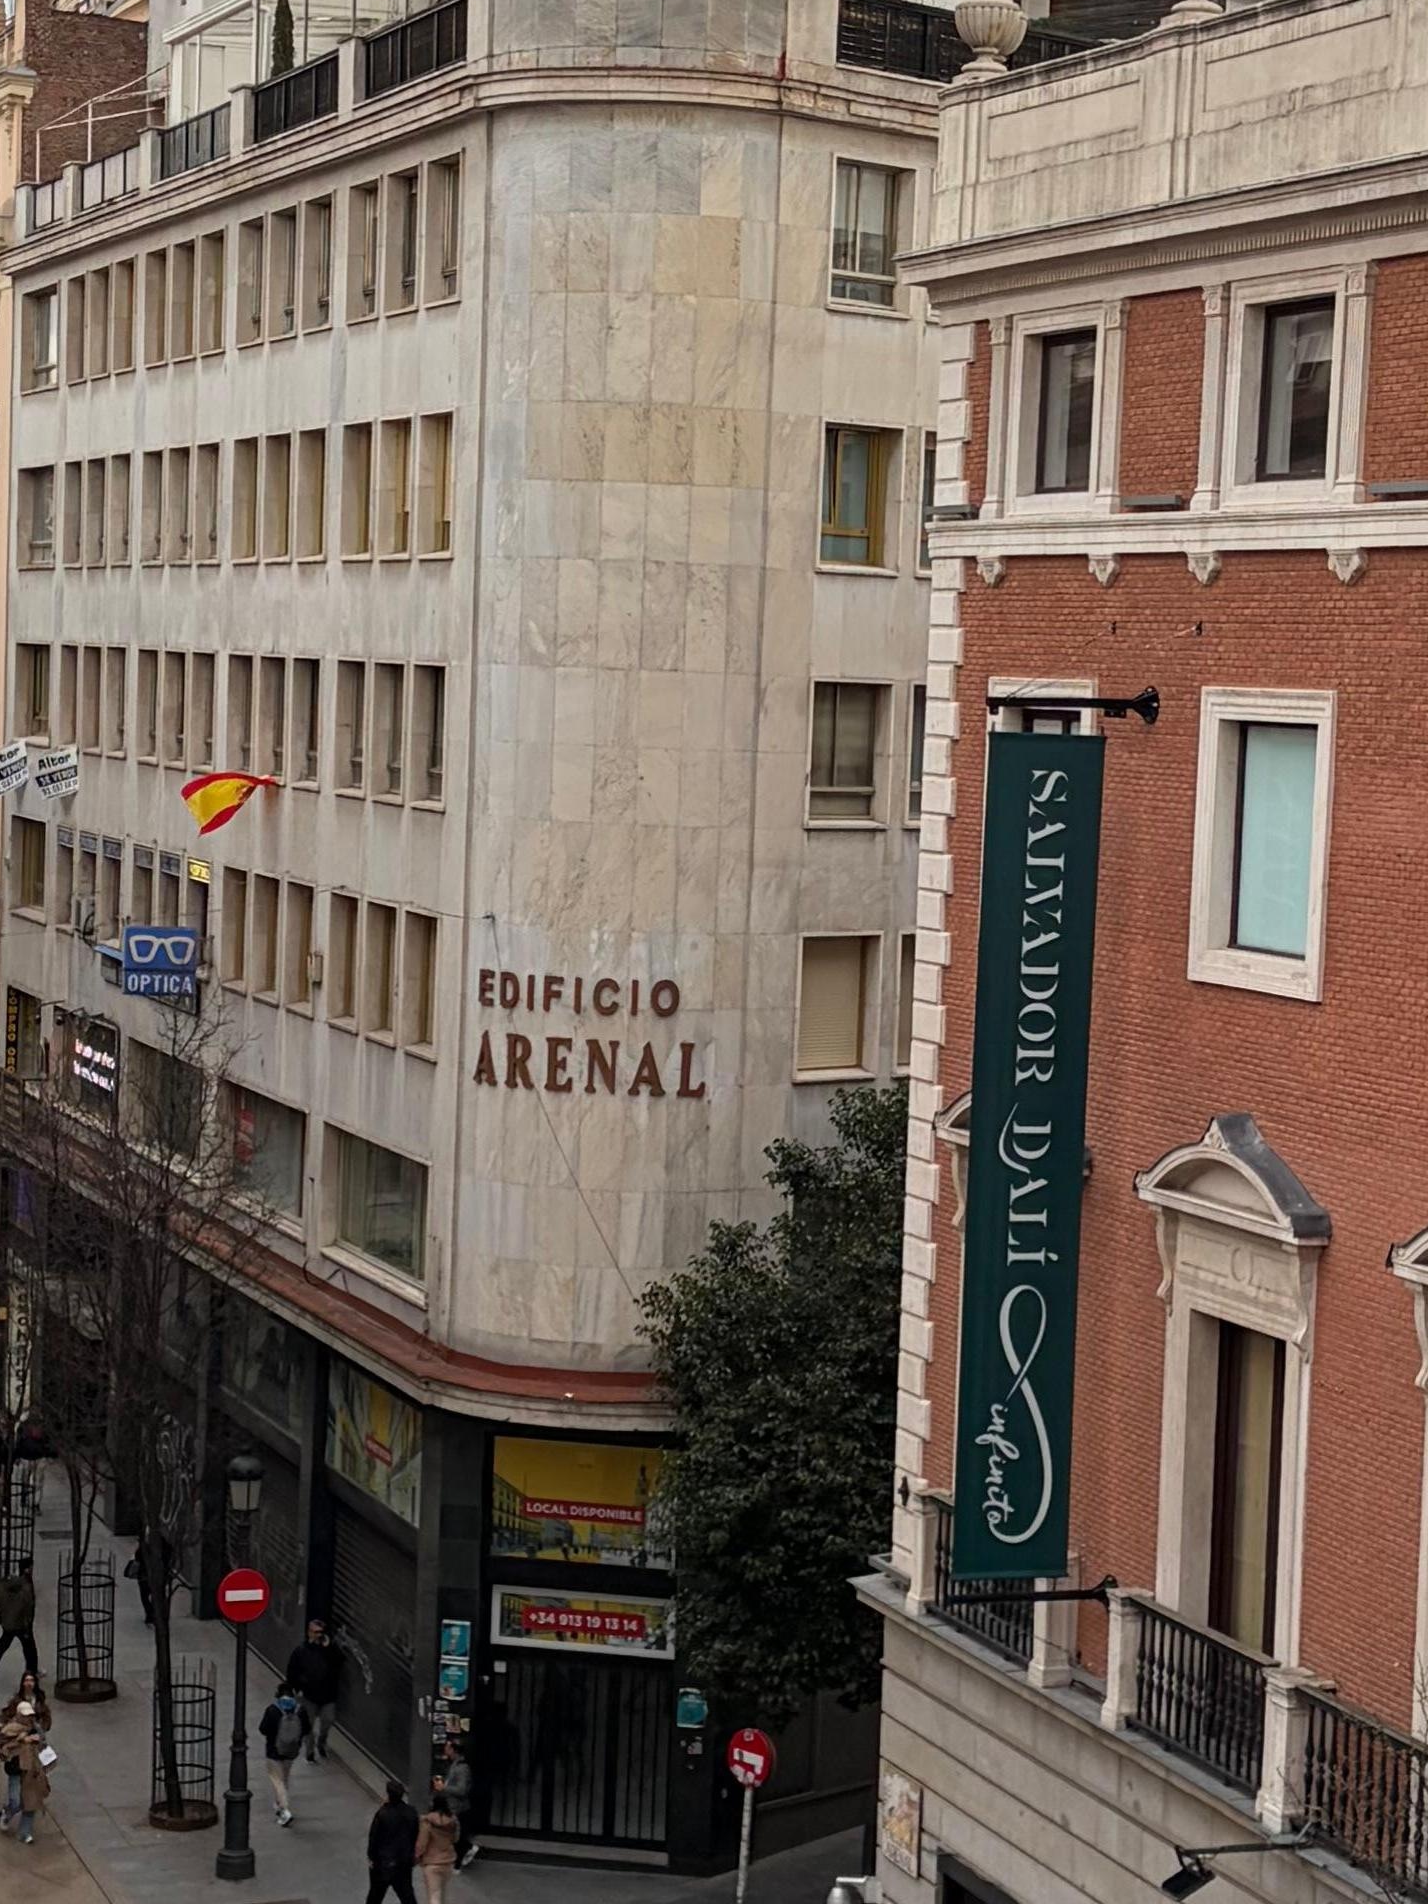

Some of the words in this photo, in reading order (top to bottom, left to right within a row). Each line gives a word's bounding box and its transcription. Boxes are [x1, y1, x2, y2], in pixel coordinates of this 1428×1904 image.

[1014, 767, 1067, 1087] SALVADOR
[127, 973, 193, 995] OPTICA
[478, 968, 682, 1019] EDIFICIO
[5, 1047, 16, 1074] ORO
[473, 1028, 708, 1100] ARENAL
[996, 1102, 1058, 1268] DALÍ
[977, 1400, 1021, 1542] infinito
[526, 1502, 567, 1515] LOCAL
[570, 1506, 643, 1521] DISPONIBLE
[528, 1611, 556, 1625] +34
[558, 1614, 583, 1628] 913
[586, 1615, 602, 1629] 19
